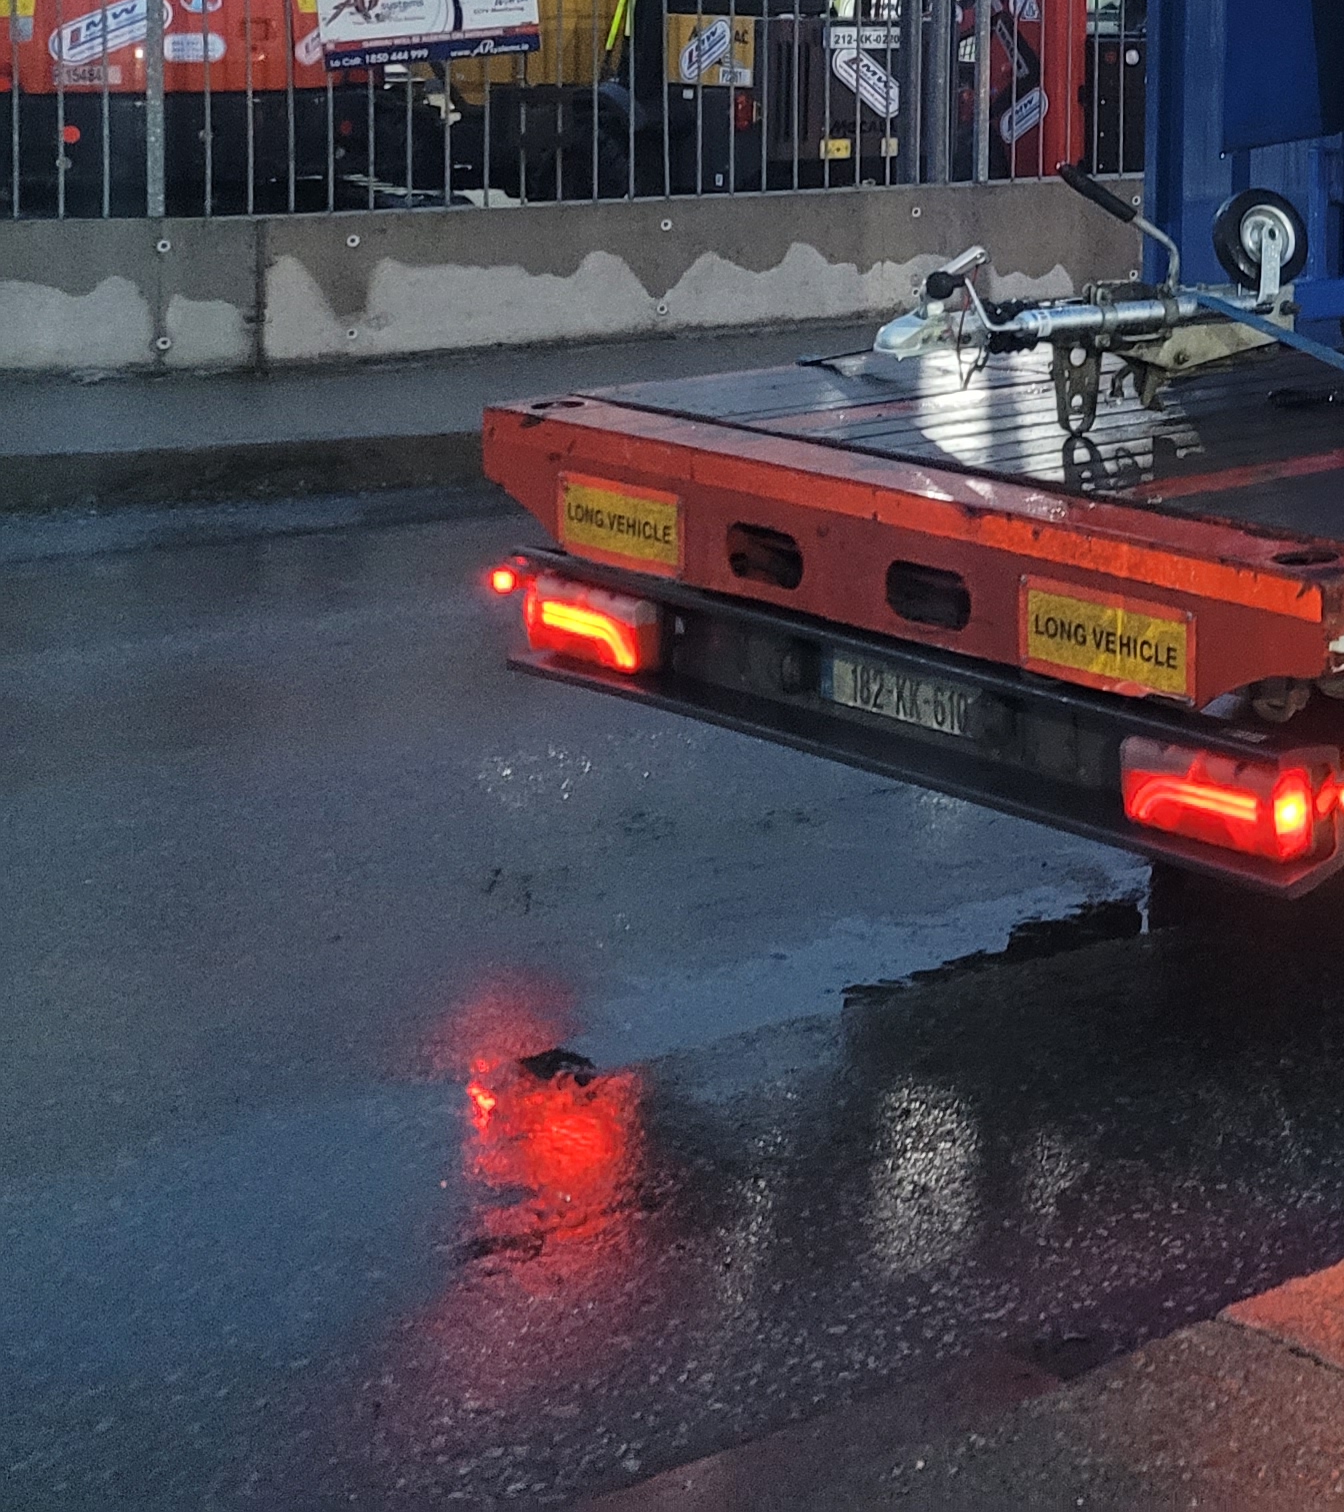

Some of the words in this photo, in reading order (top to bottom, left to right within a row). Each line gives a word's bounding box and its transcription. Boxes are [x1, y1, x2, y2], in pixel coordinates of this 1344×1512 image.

[567, 502, 605, 529] LONG
[607, 511, 672, 545] VEHICLE
[1034, 613, 1088, 648] LONG
[1091, 625, 1178, 671] VEHICLE
